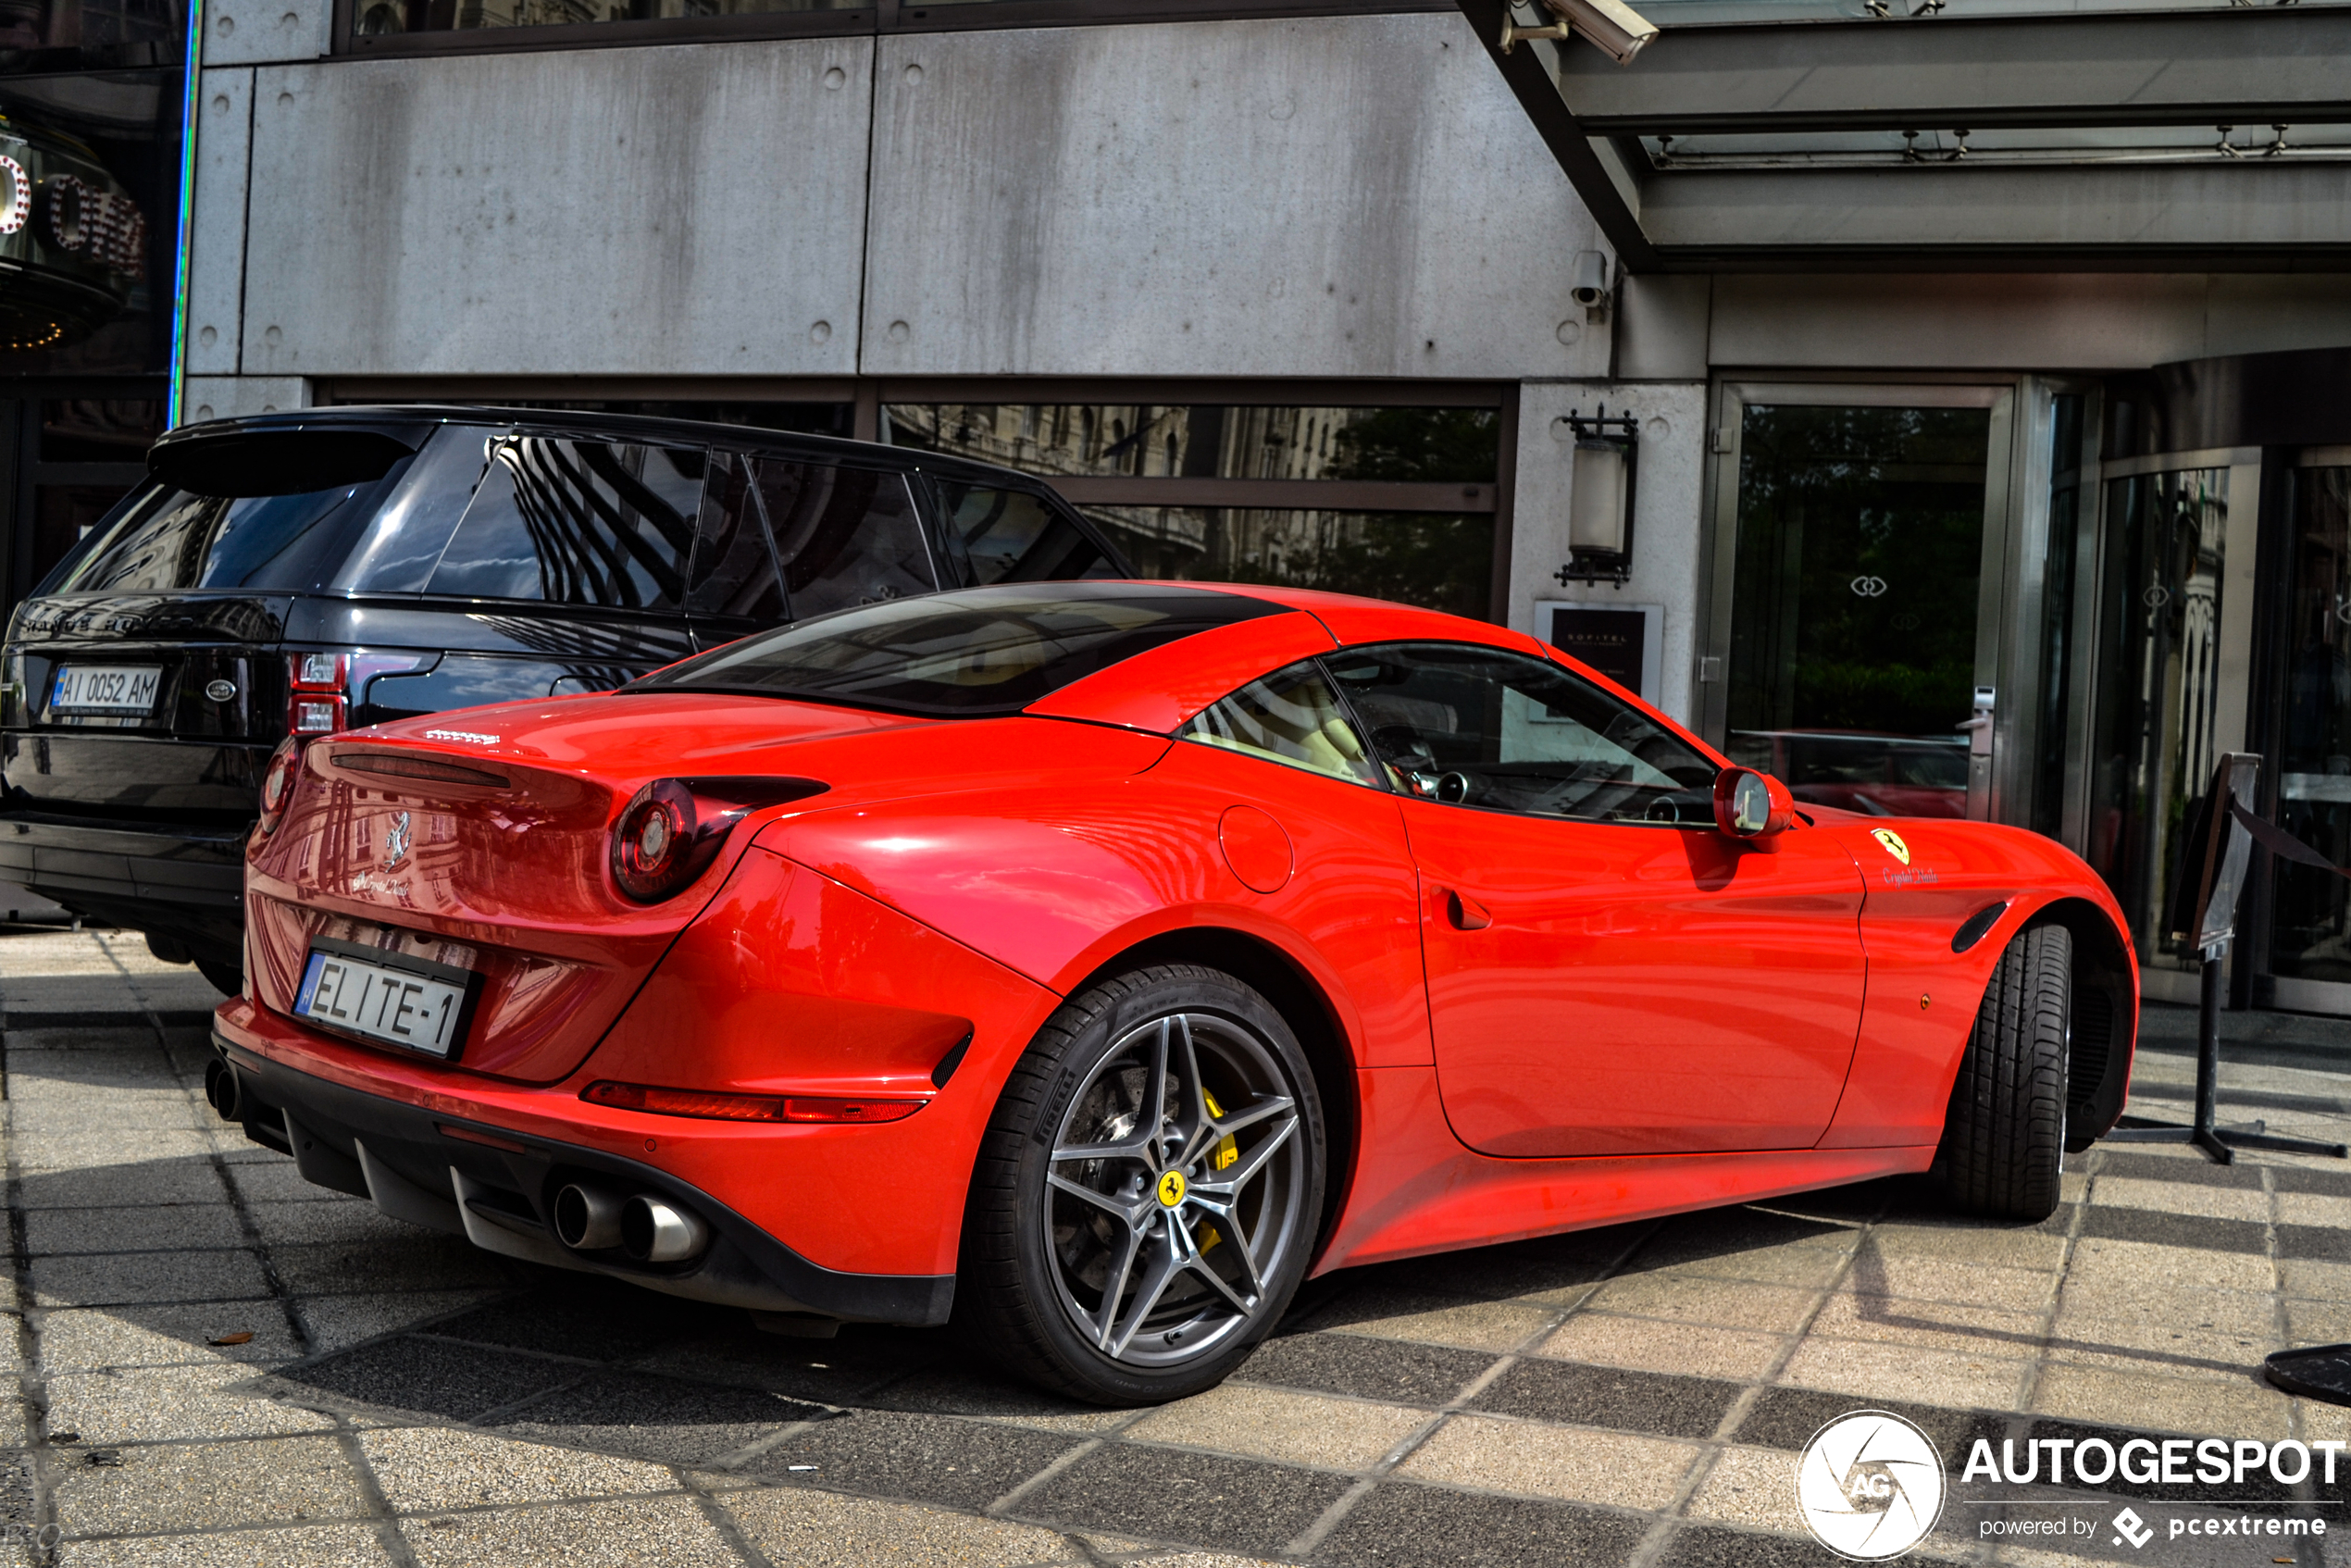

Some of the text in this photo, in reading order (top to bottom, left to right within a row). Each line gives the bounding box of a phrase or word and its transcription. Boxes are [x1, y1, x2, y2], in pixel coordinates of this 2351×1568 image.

[1567, 633, 1627, 642] SOFITEL
[61, 673, 157, 703] AI 0052 AM
[363, 875, 409, 897] Crystal Nails
[1883, 867, 1939, 890] Crystal Nails
[301, 988, 312, 1006] H
[1032, 1066, 1076, 1147] PIRELLI
